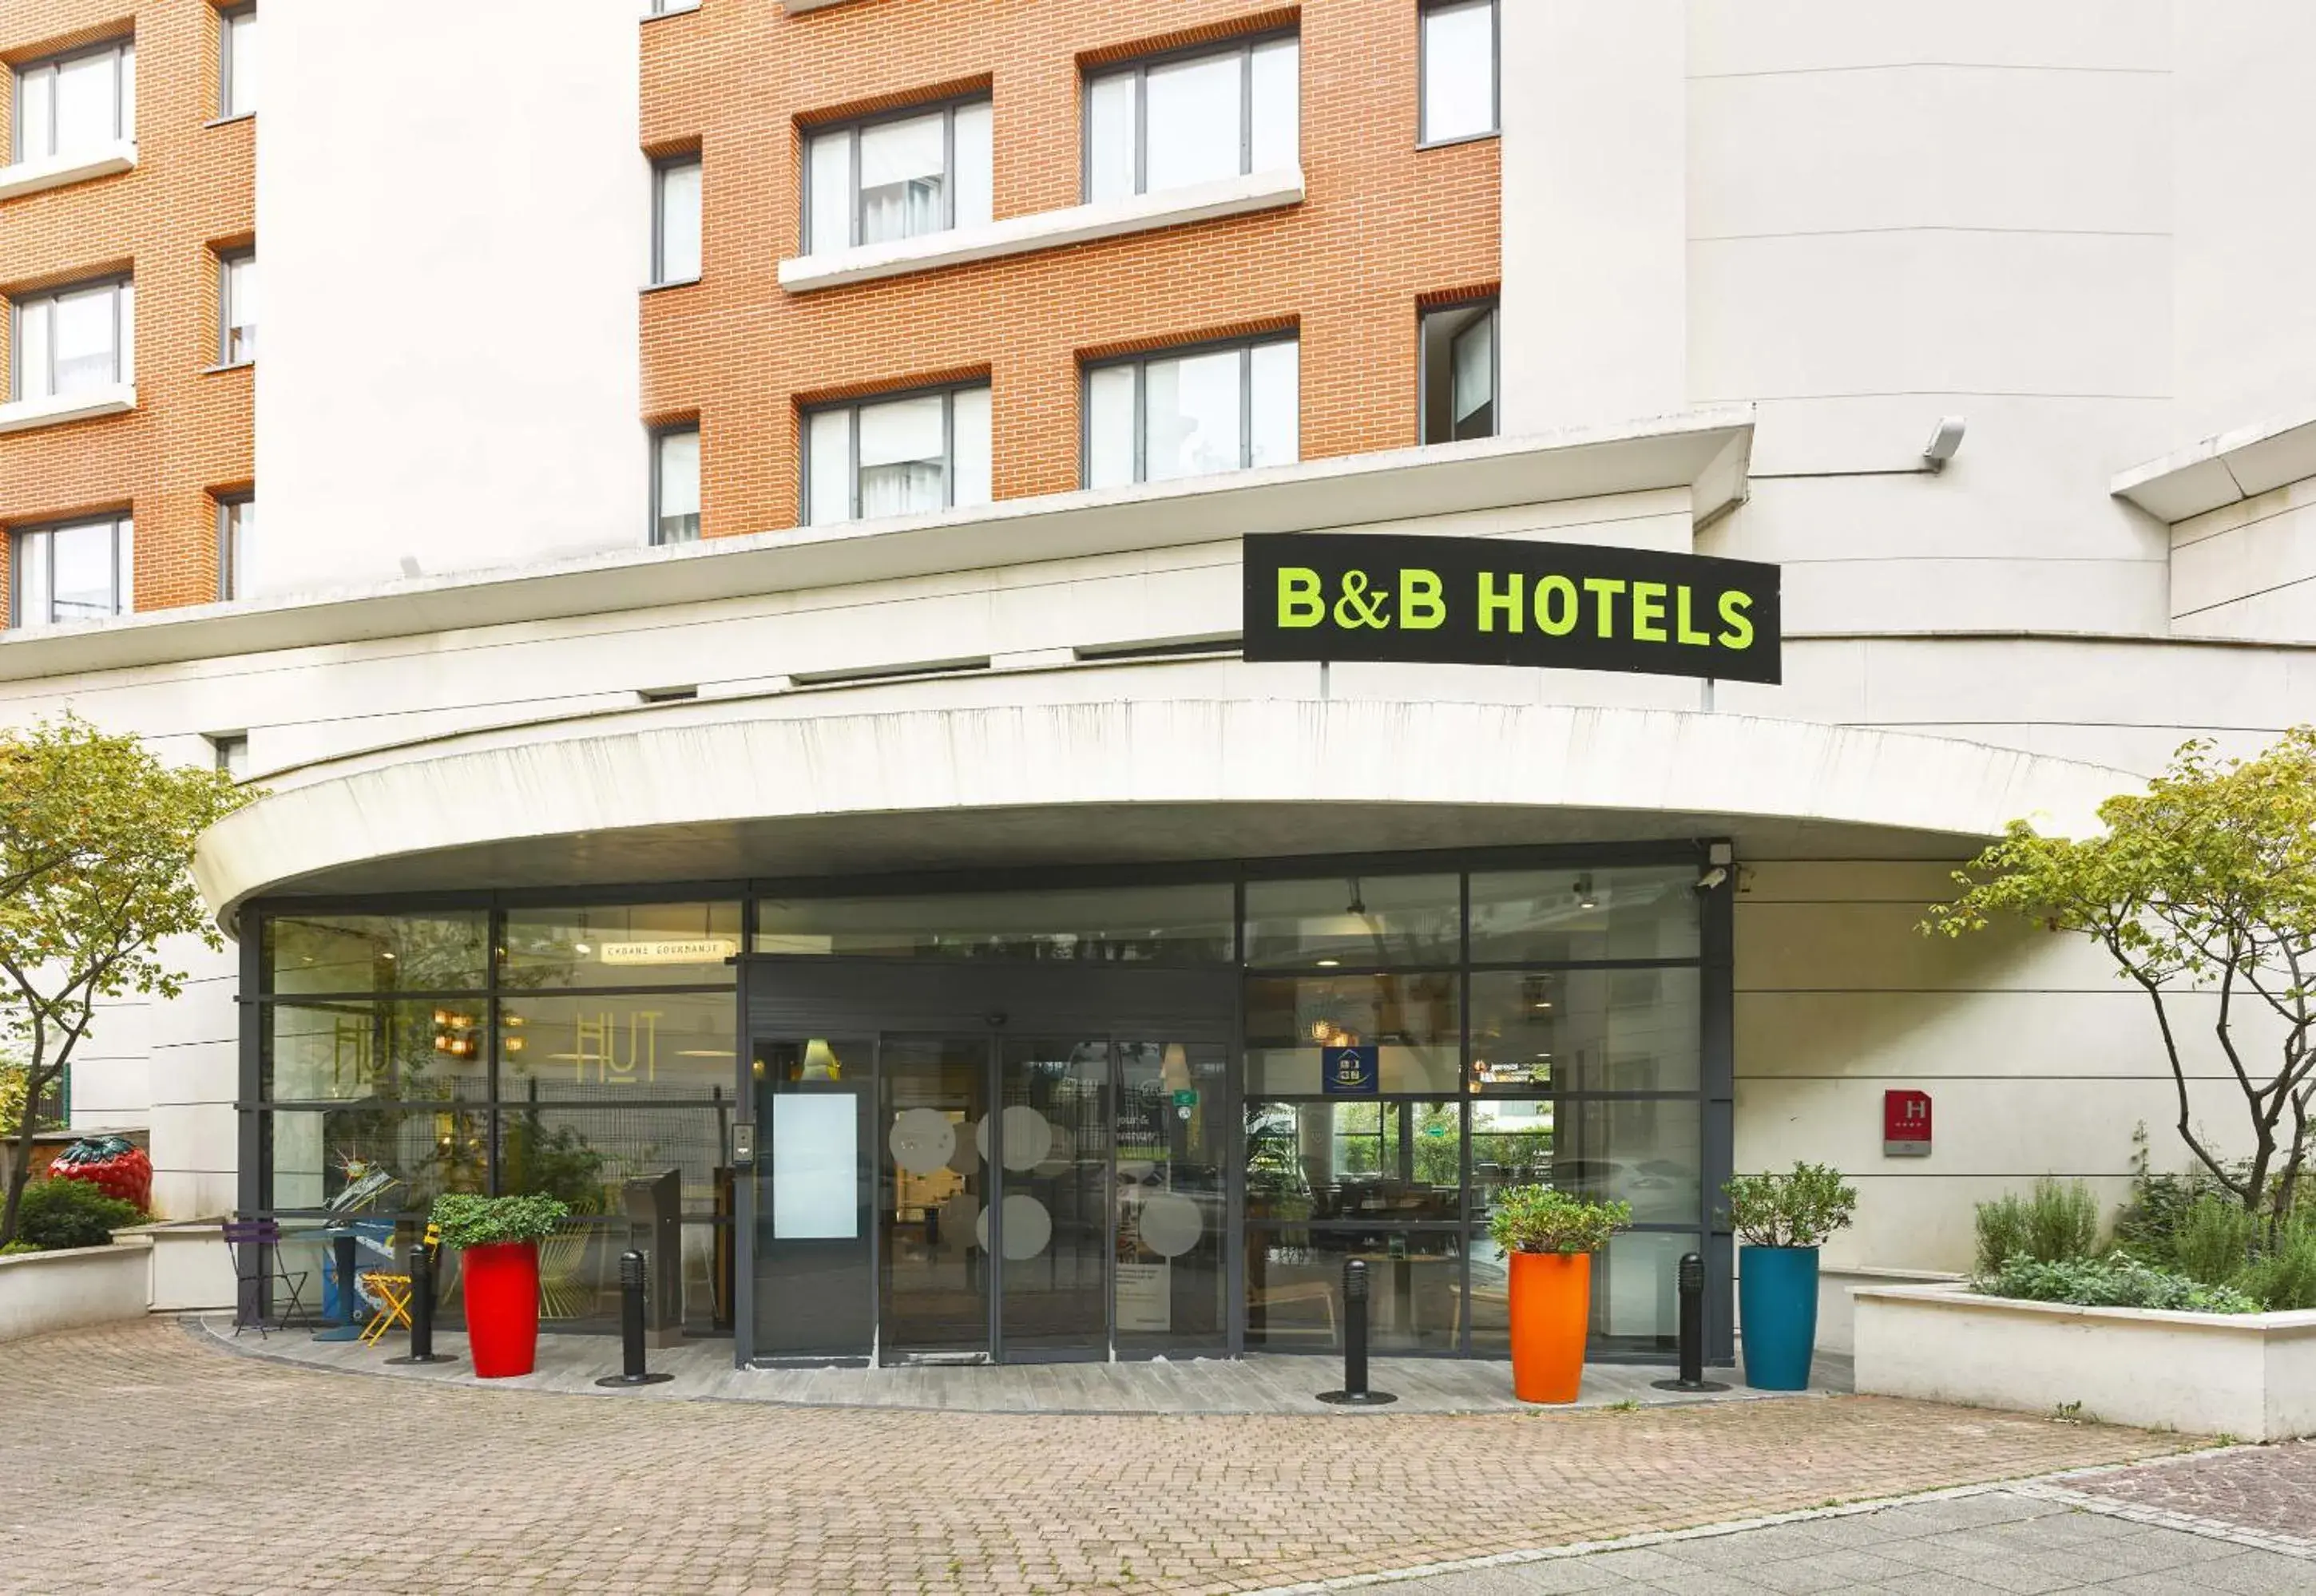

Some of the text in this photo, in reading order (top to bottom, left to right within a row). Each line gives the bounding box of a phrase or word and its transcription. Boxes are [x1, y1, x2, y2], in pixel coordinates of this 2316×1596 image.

[1278, 567, 1754, 650] B&B HOTELS
[577, 1011, 664, 1083] HUT
[1906, 1100, 1925, 1119] H
